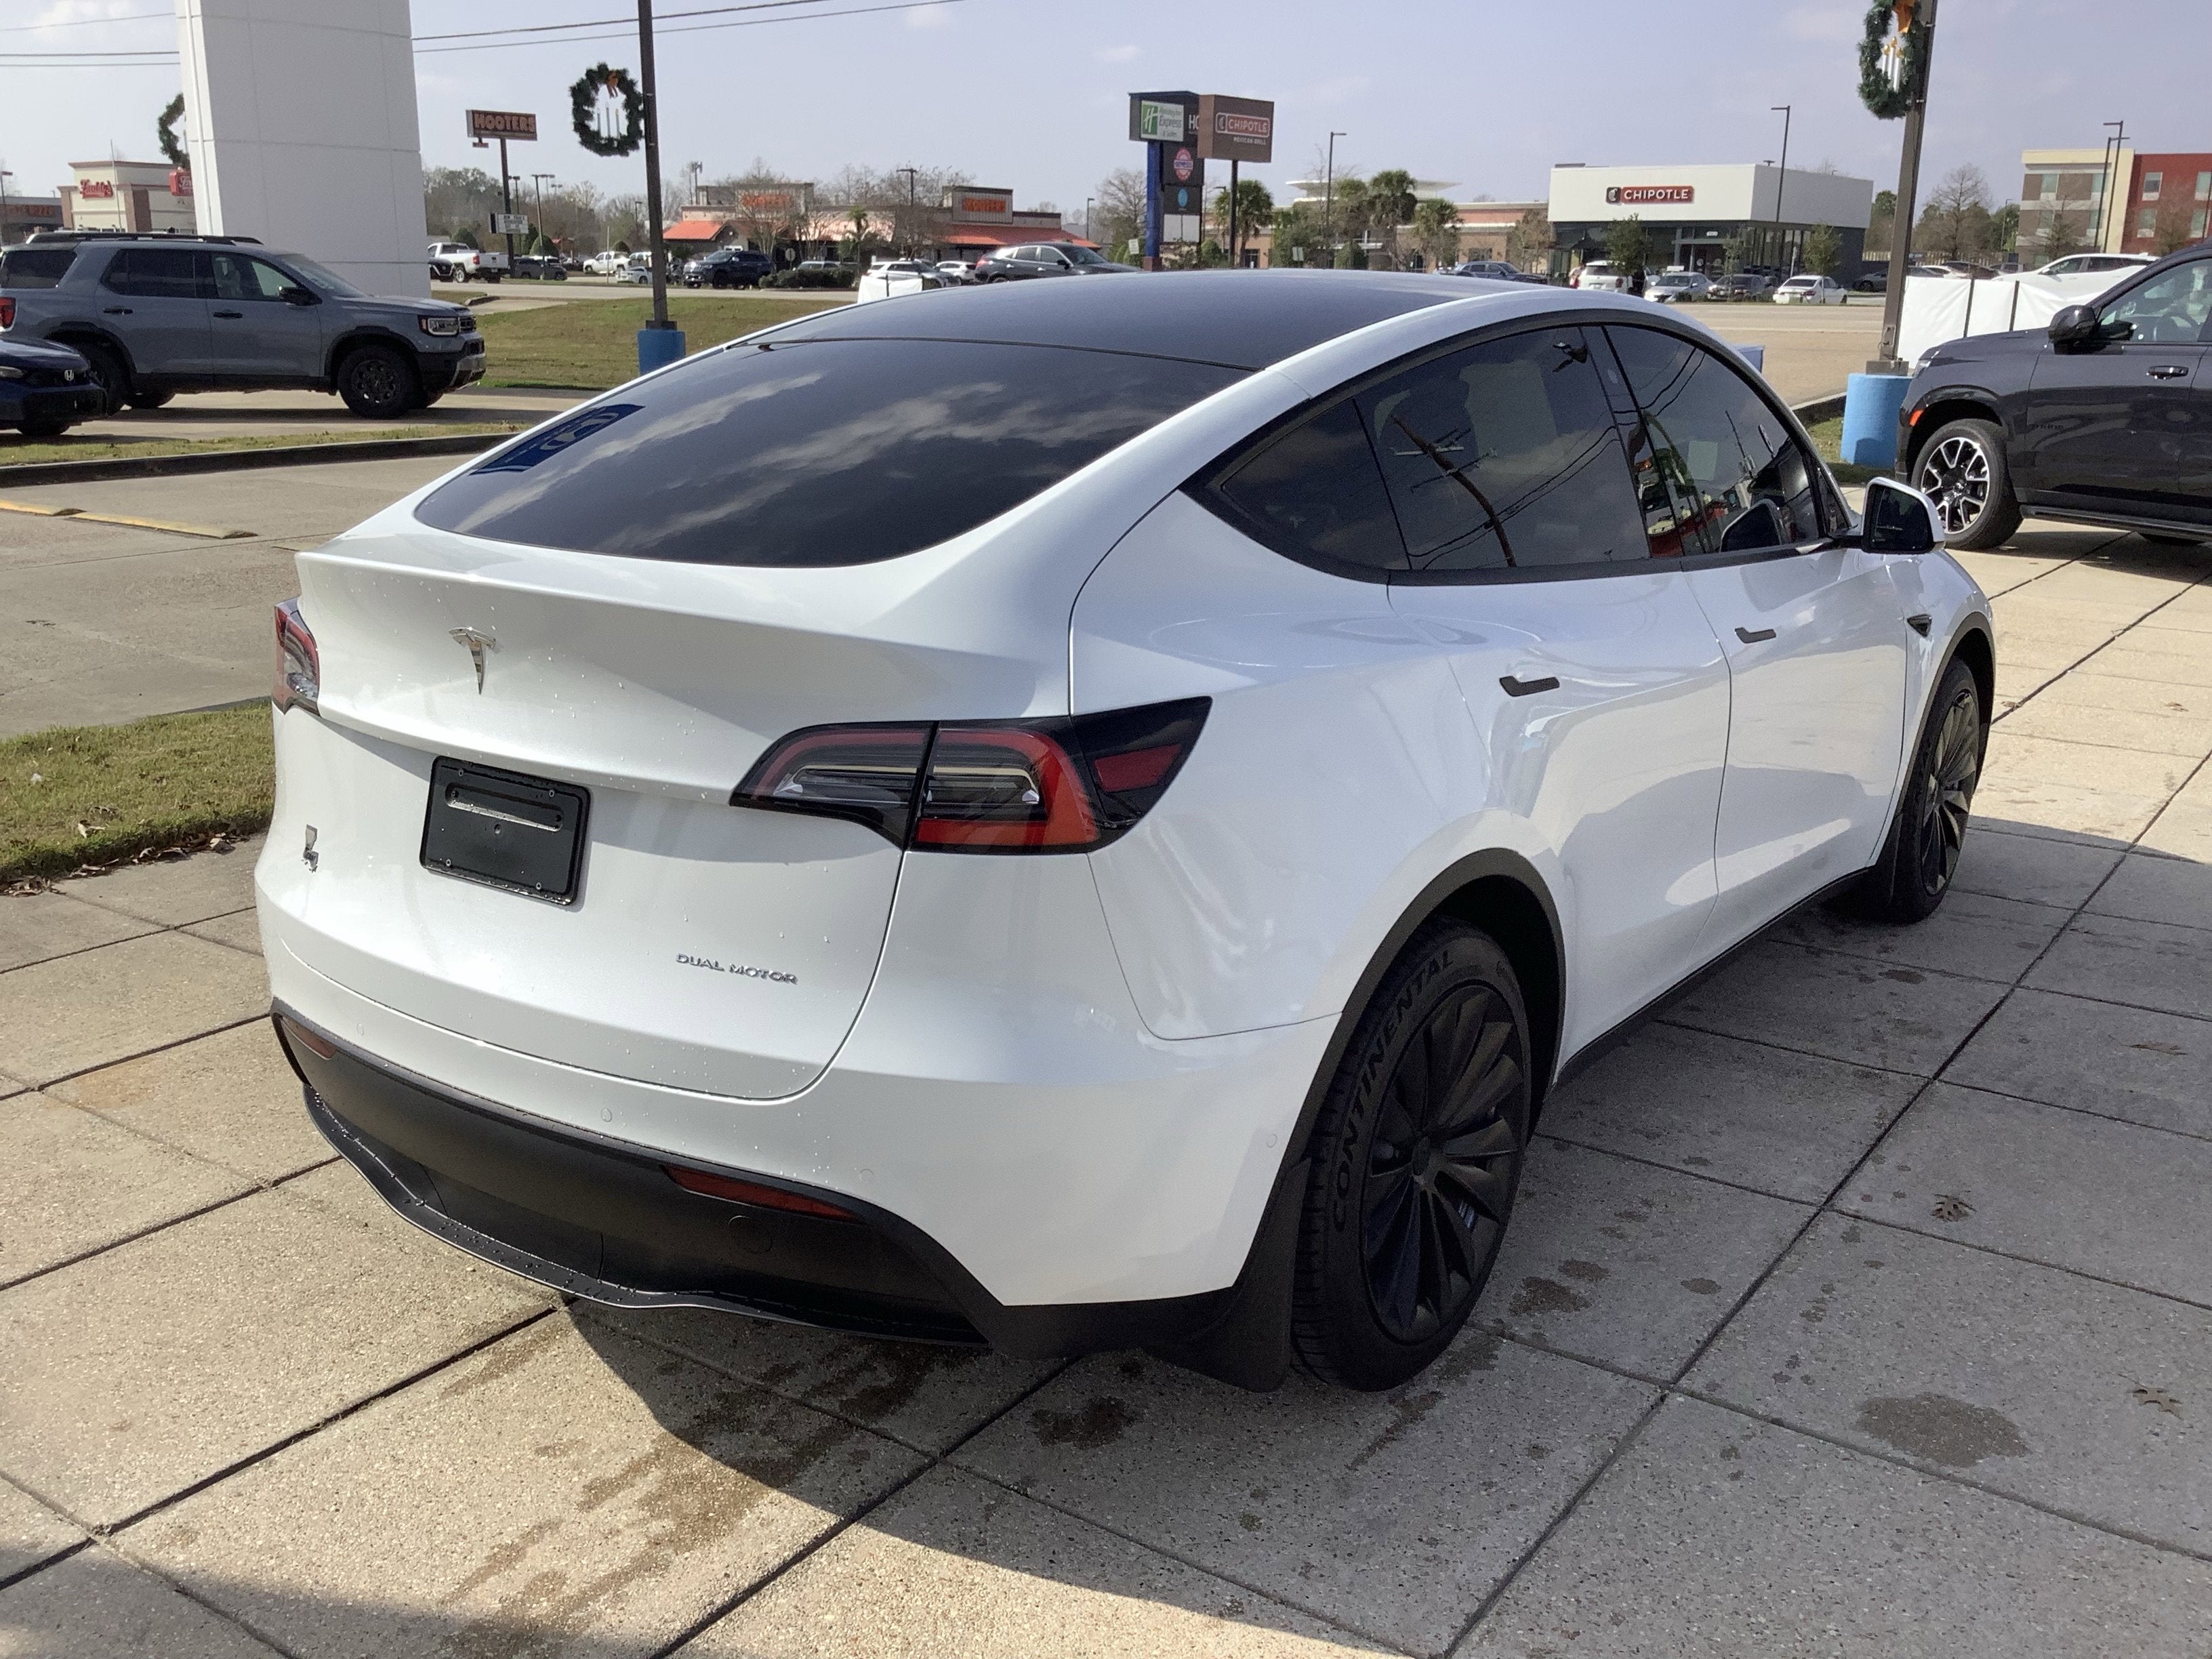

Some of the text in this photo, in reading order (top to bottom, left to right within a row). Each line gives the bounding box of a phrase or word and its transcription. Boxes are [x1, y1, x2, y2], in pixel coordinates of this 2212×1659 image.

[474, 113, 535, 132] HOOTERS
[1159, 115, 1182, 129] Express
[1228, 118, 1268, 133] CHIPOTLE
[1624, 189, 1689, 200] CHIPOTLE
[676, 953, 798, 985] DUAL MOTOR
[1333, 949, 1454, 1232] CONTINENTAL
